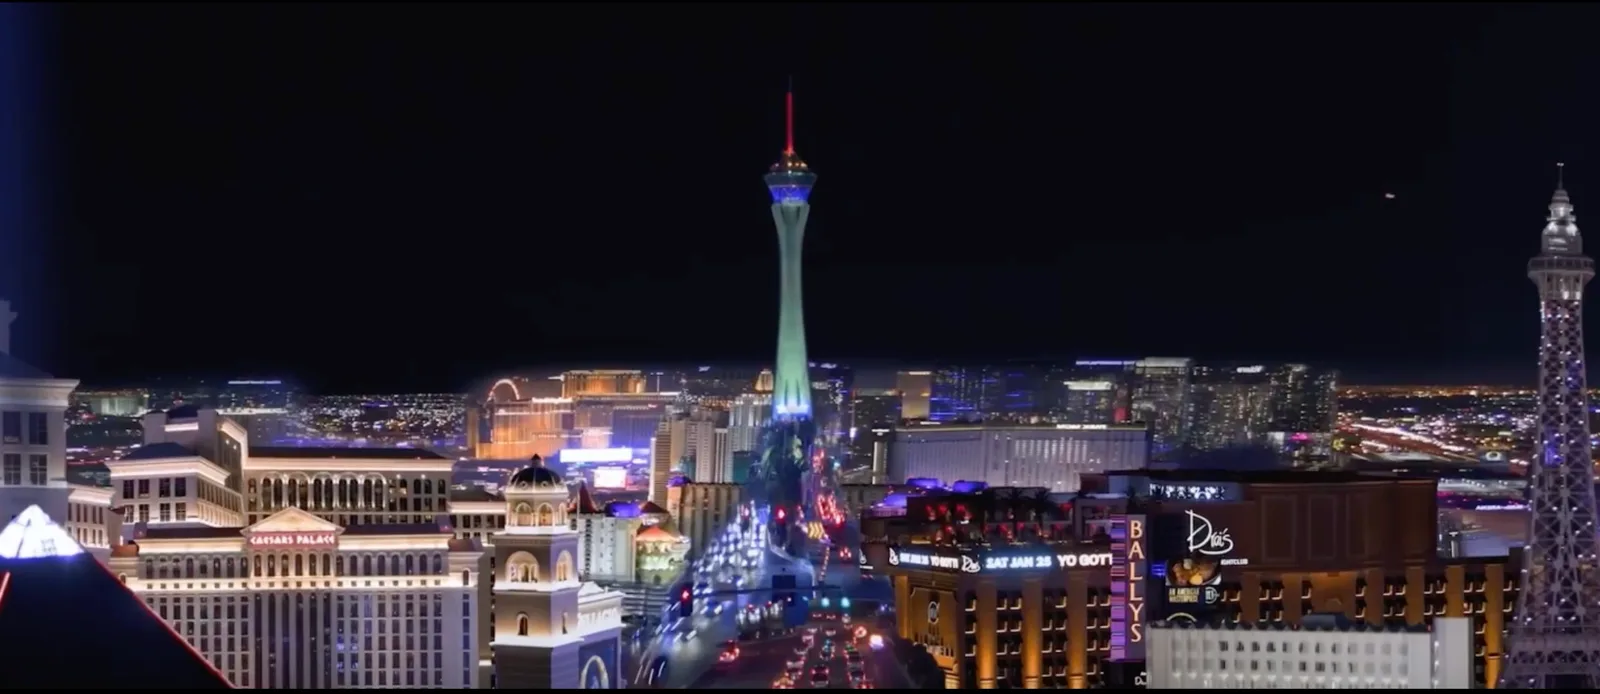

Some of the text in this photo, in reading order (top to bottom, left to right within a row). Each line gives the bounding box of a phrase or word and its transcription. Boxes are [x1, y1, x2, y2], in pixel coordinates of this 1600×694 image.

[251, 535, 335, 545] CAESARS PALACE
[1185, 509, 1234, 555] Drai's
[986, 553, 1112, 569] SAT JAN 25 YO GOTT
[1127, 519, 1145, 642] BALLYS
